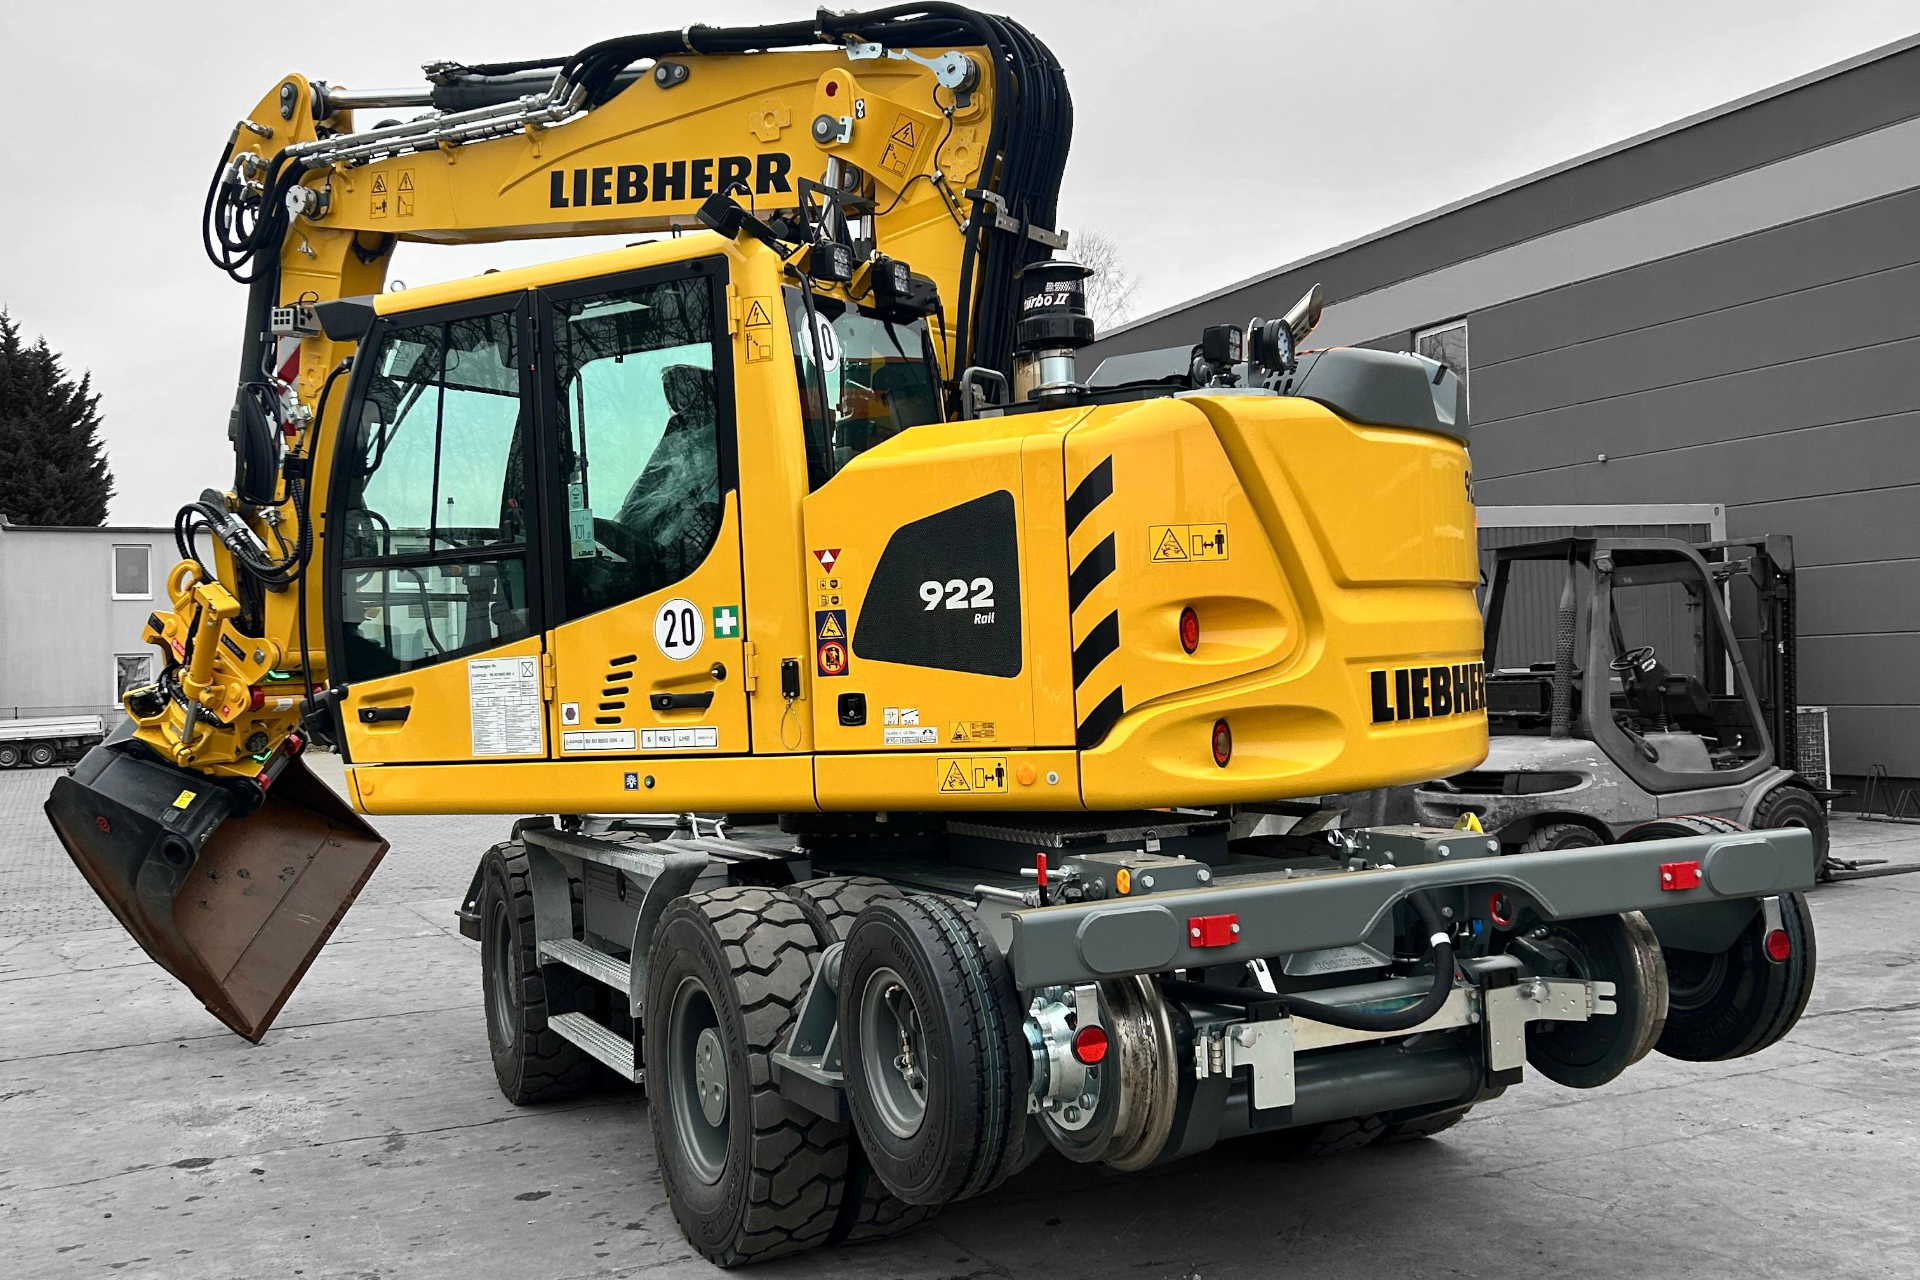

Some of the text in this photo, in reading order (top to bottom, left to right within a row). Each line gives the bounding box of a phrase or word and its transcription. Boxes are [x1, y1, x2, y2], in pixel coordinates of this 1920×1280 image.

[550, 152, 792, 208] LIEBHERR
[574, 524, 585, 540] 101
[919, 577, 995, 611] 922
[663, 607, 696, 648] 20
[974, 611, 995, 624] Rail
[658, 735, 672, 743] REV
[890, 935, 938, 1035] Continental
